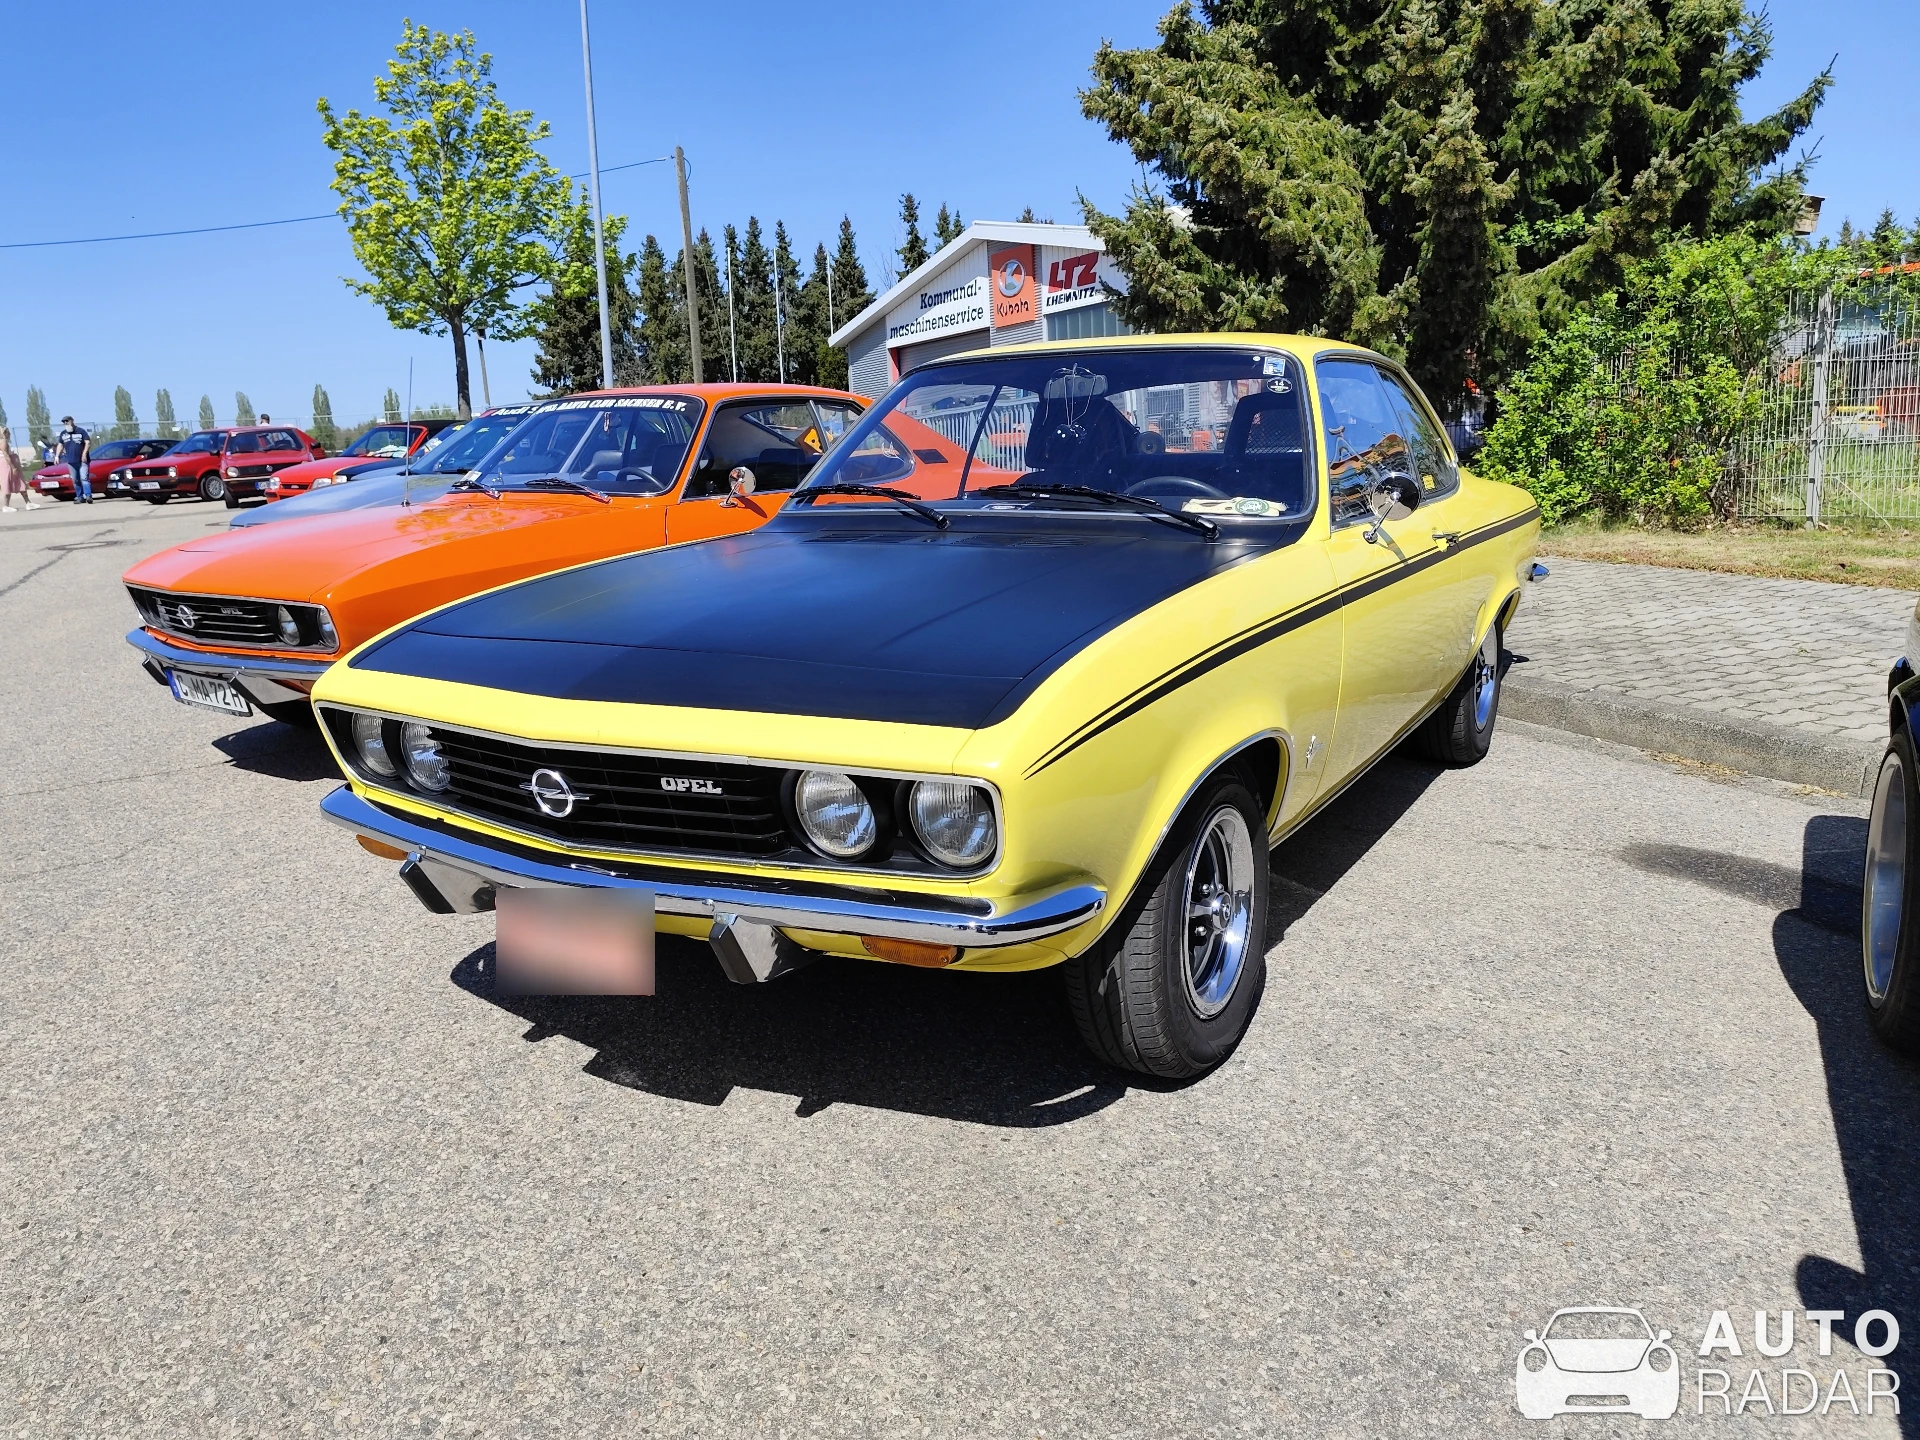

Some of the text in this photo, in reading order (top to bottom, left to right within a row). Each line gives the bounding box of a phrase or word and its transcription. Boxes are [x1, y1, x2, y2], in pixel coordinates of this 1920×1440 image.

[1048, 252, 1099, 294] LTZ
[920, 279, 981, 310] Kommunal-
[1046, 286, 1096, 307] CHEMNITZ
[996, 298, 1029, 317] Kubota
[890, 306, 984, 339] maschinenservice
[491, 406, 531, 417] Audi
[660, 777, 722, 794] OPEL
